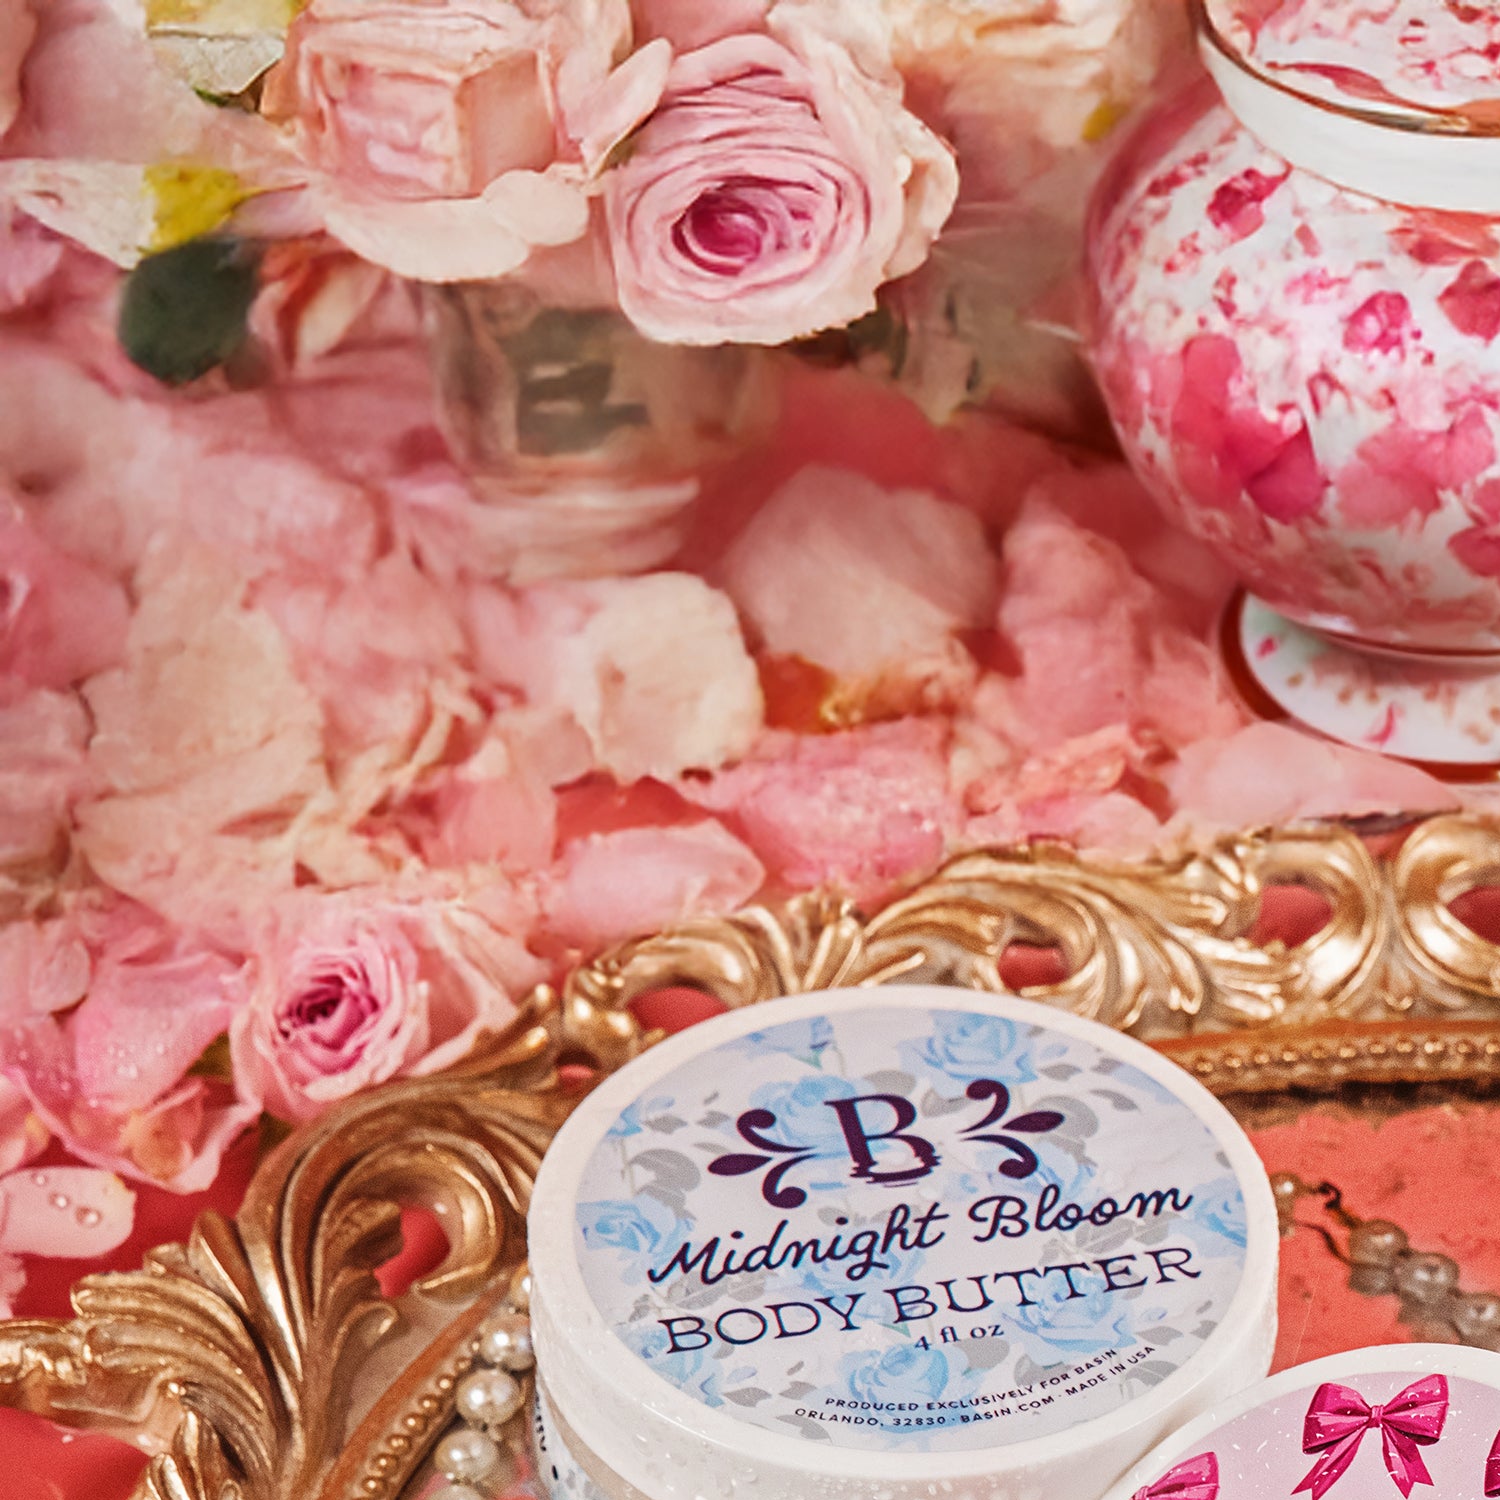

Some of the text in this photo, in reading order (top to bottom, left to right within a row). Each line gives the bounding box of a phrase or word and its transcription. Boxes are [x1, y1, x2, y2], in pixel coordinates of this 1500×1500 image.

[824, 1093, 943, 1187] B
[647, 1184, 1195, 1285] Midnight Bloom
[657, 1246, 1201, 1354] BODY BUTTER
[914, 1324, 1005, 1351] 4 fl oz
[825, 1349, 1118, 1412] PRODUCED EXCLUSIVELY FOR BASIN
[892, 1416, 946, 1427] 32830
[961, 1395, 1056, 1423] BASIN.COM
[1065, 1373, 1108, 1397] MADE
[1110, 1362, 1126, 1377] IN
[1127, 1345, 1156, 1367] USA
